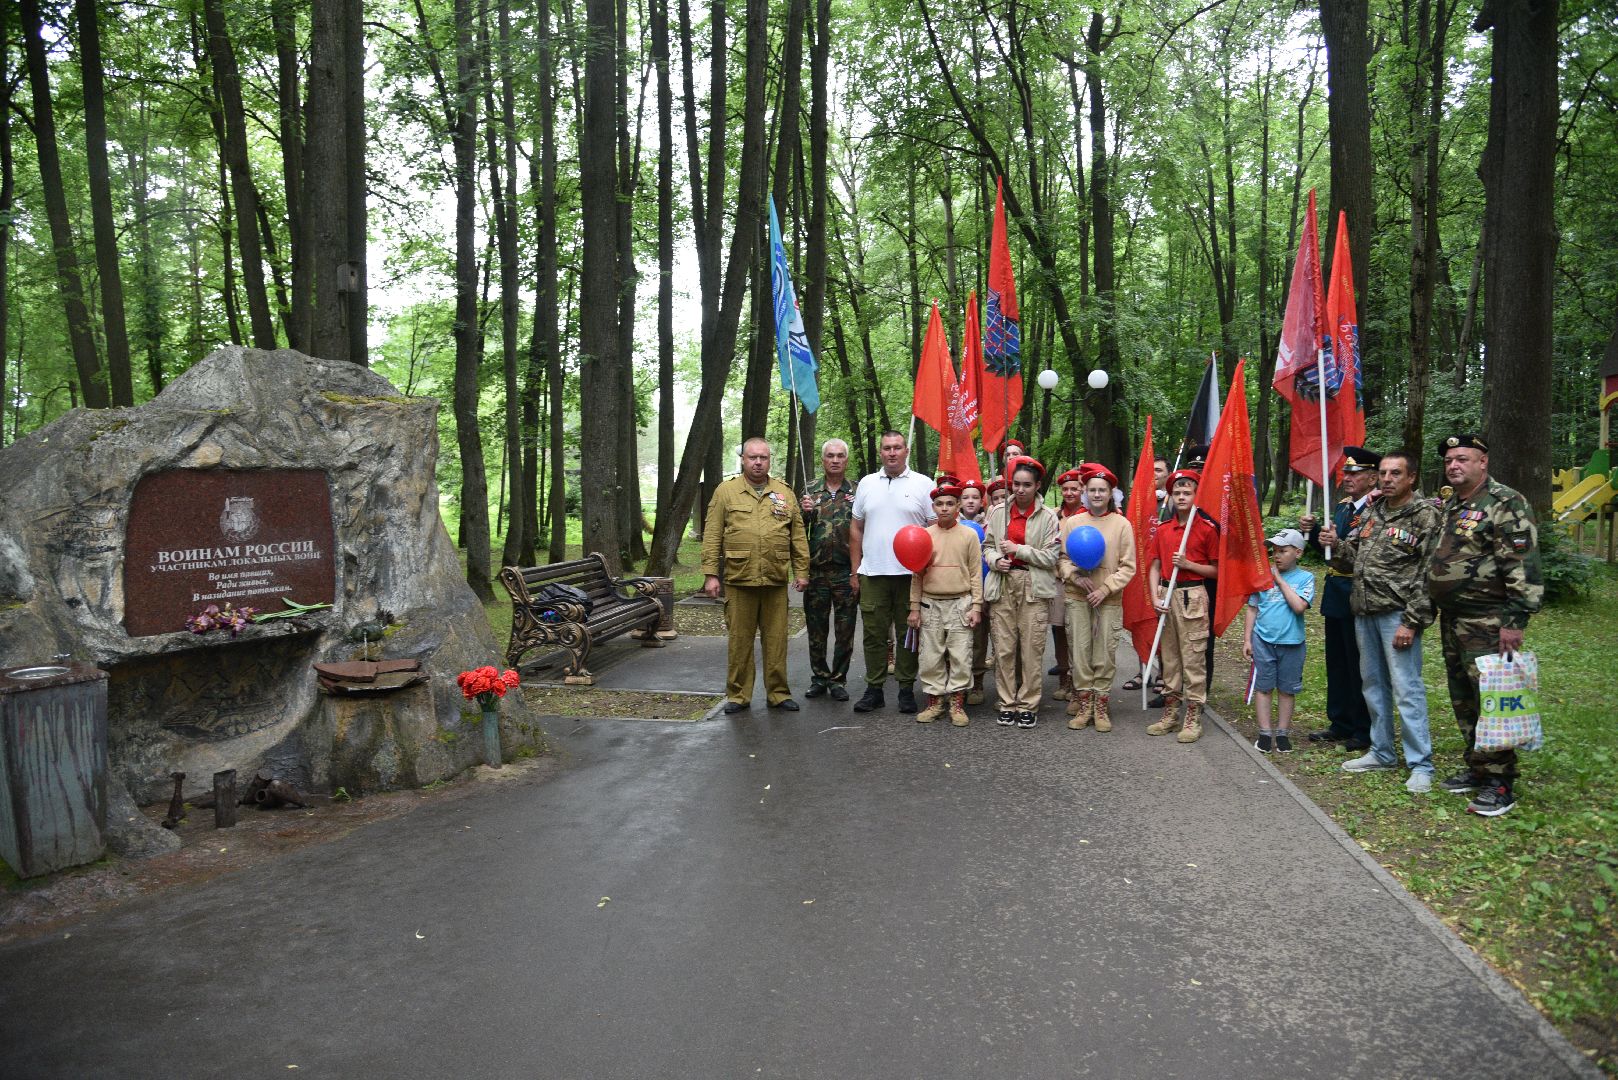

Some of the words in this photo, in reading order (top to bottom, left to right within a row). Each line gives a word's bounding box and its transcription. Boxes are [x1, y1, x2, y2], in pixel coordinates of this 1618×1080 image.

[158, 545, 240, 563] ВОИНАМ
[245, 540, 314, 557] РОССИИ
[151, 559, 227, 573] УЧАСТНИКАМ
[229, 554, 292, 566] ЛОКАЛЬНЫХ
[208, 572, 220, 581] Во
[221, 572, 238, 580] имя
[215, 580, 237, 590] Ради
[192, 593, 200, 602] В
[201, 589, 246, 600] назидание
